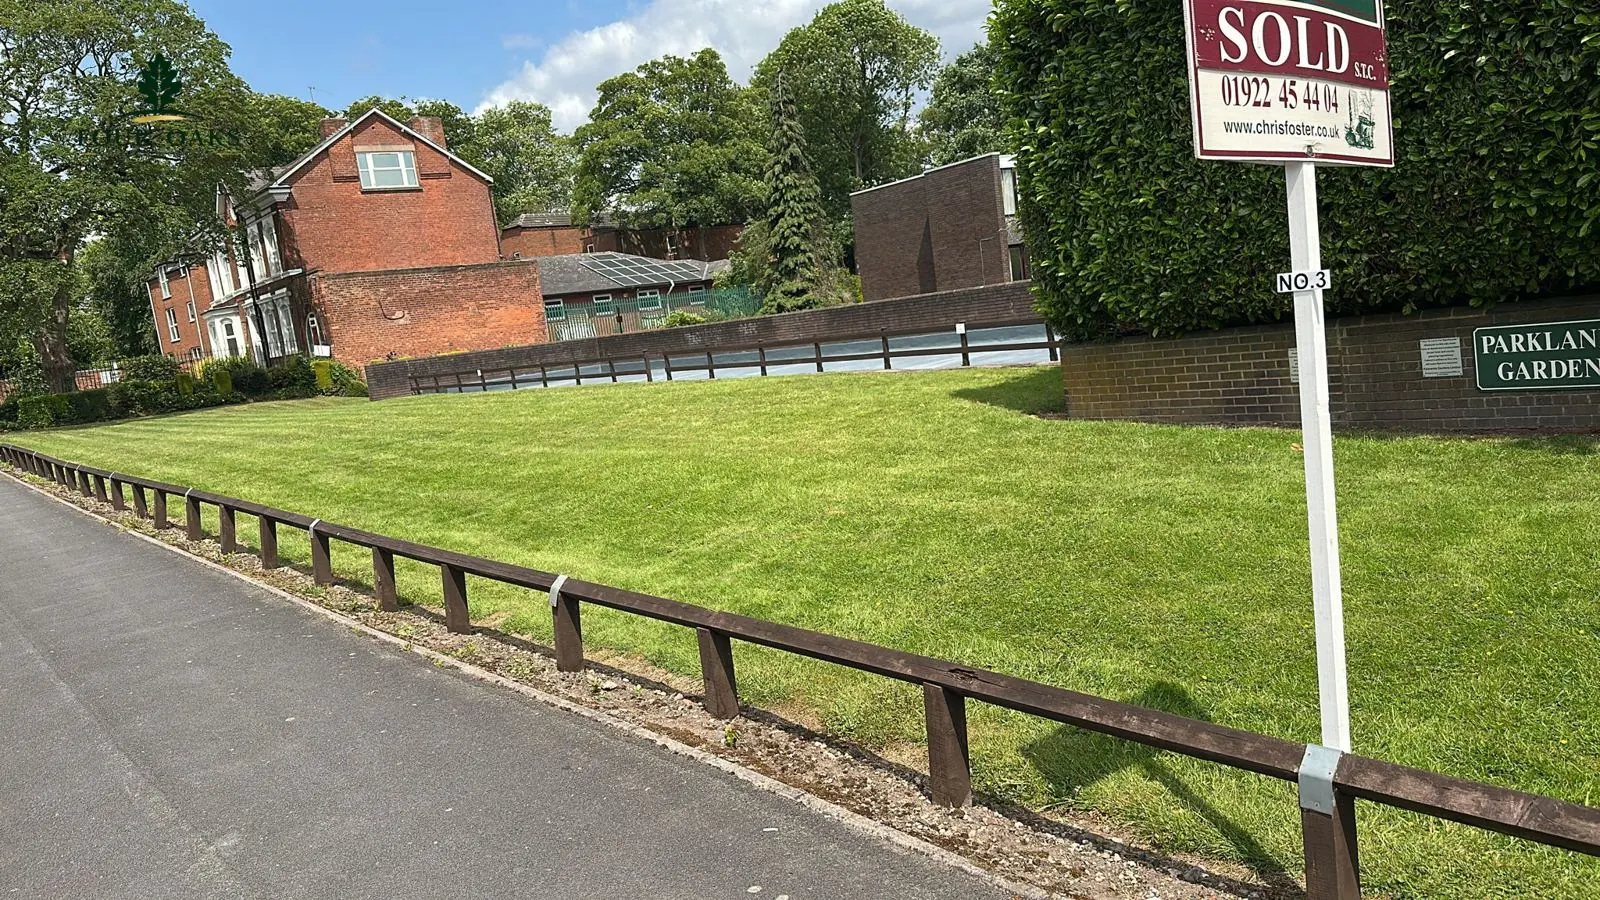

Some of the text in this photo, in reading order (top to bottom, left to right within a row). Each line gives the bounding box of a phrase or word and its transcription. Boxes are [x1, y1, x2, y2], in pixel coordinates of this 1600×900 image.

[1218, 6, 1377, 80] SOLD S.T.C.
[1221, 74, 1339, 113] 01922 45 44 04
[1223, 119, 1340, 139] www.chrisfoster.co.uk
[1279, 271, 1326, 291] NO.3
[1481, 328, 1600, 354] PARKLAN
[1497, 357, 1600, 381] GARDEN
